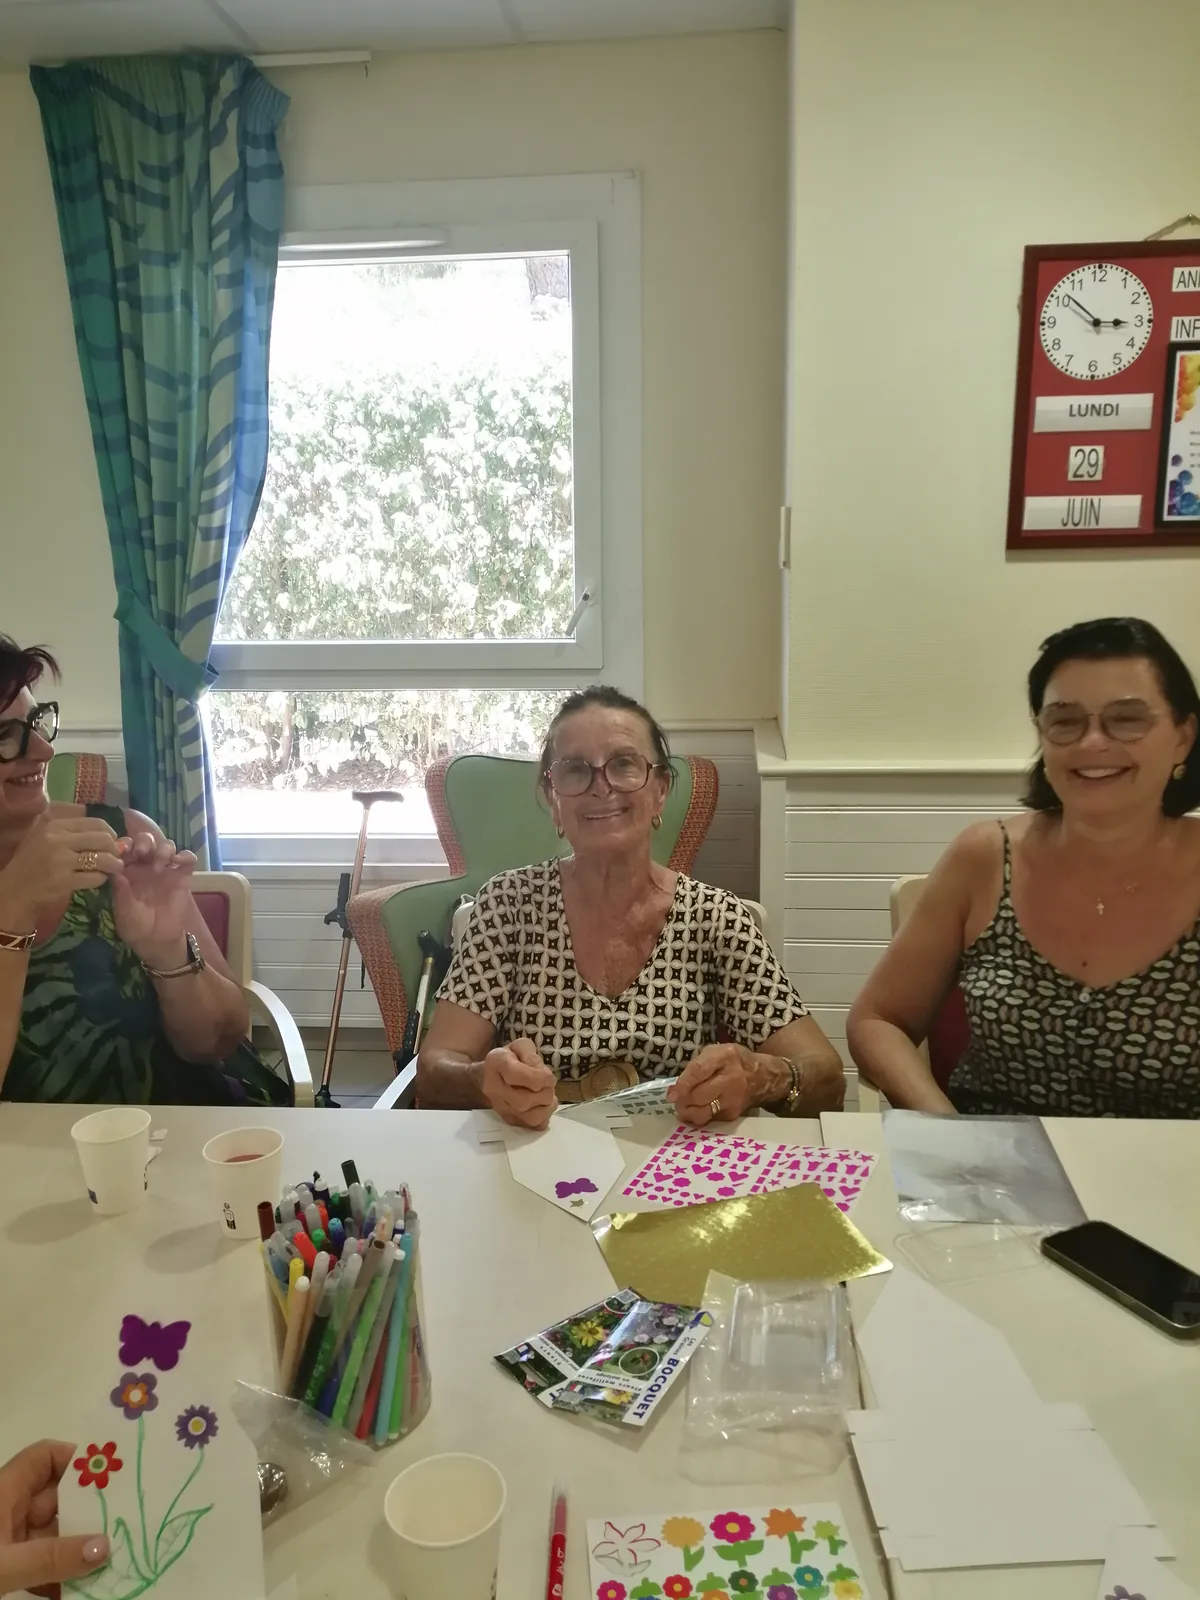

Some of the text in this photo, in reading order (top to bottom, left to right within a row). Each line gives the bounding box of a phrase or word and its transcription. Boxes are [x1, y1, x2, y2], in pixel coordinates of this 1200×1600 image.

[1091, 269, 1108, 282] 12
[1176, 270, 1200, 288] AN
[1070, 278, 1083, 291] 11
[1121, 277, 1128, 289] 1
[1054, 295, 1070, 308] 10
[1130, 292, 1141, 305] 2
[1047, 316, 1056, 329] 9
[1134, 315, 1143, 327] 3
[1052, 338, 1061, 351] 8
[1126, 336, 1135, 349] 4
[1065, 354, 1074, 367] 7
[1112, 353, 1122, 365] 5
[1088, 360, 1098, 373] 6
[1069, 403, 1120, 417] LUNDI
[1072, 448, 1099, 478] 29
[1061, 498, 1101, 527] JUIN
[633, 1357, 680, 1419] BOCQUET
